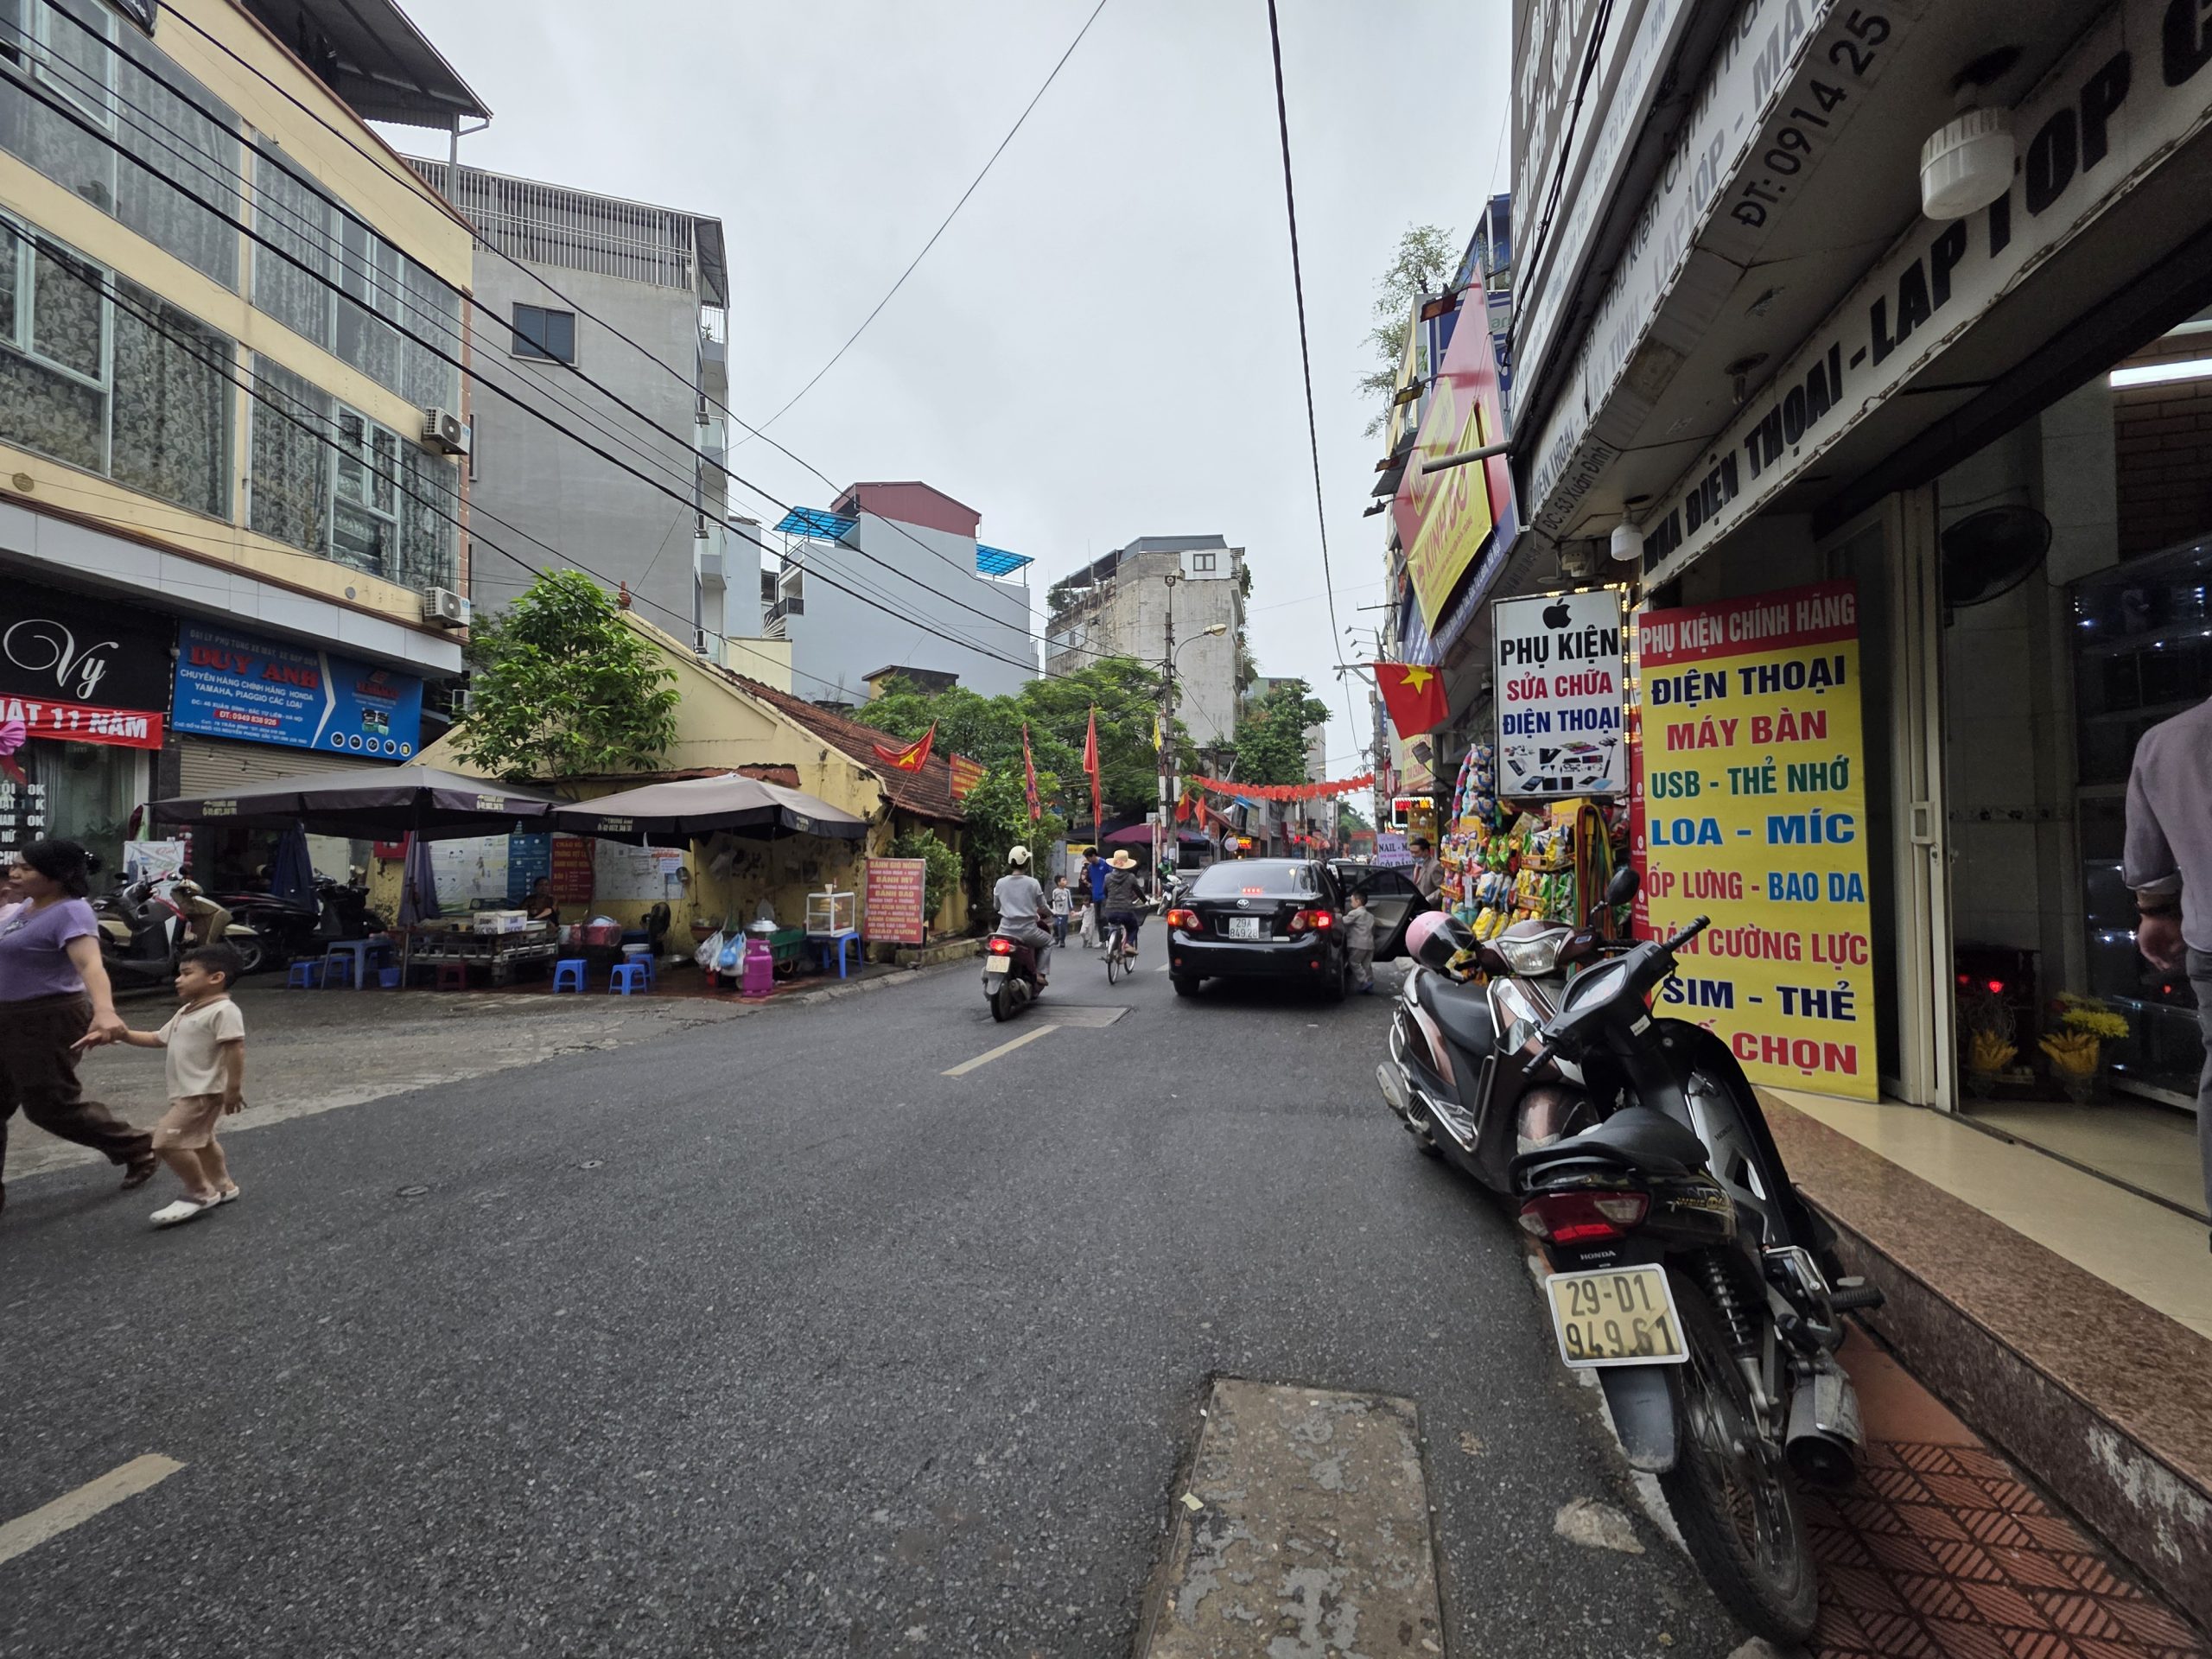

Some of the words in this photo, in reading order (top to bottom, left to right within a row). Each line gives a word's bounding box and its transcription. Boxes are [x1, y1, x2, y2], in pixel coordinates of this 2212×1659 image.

[1686, 449, 1739, 537] ĐIỆN
[1500, 635, 1549, 669] PHỤ
[1558, 624, 1618, 664] KIỆN
[1641, 626, 1675, 658] PHỤ
[1681, 612, 1723, 653] KIỆN
[1729, 602, 1789, 642] CHÍNH
[1796, 593, 1855, 632] HÃNG
[3, 619, 119, 699] Vy
[189, 645, 252, 674] DUY
[263, 663, 319, 690] ANH
[180, 669, 215, 683] CHUYÊN
[217, 674, 239, 688] HÀNG
[289, 690, 314, 701] HONDA
[235, 690, 268, 703] PIAGGIO
[1507, 671, 1548, 702] SỬA
[1554, 668, 1613, 697] CHỮA
[1651, 669, 1726, 708] ĐIỆN
[1738, 655, 1845, 694] THOẠI
[51, 708, 79, 730] 11
[89, 710, 147, 739] NĂM
[1503, 708, 1551, 739] ĐIỆN
[1557, 706, 1620, 734] THOẠI
[1667, 715, 1738, 751] MÁY
[1751, 707, 1827, 744] BÀN
[1651, 770, 1700, 798] USB
[1727, 755, 1777, 795] THẺ
[1787, 754, 1849, 792] NHỚ
[1379, 843, 1396, 852] NAIL
[1651, 817, 1723, 846] LOA
[1767, 808, 1855, 845] MÍC
[1648, 861, 1675, 898] ỐP
[1682, 868, 1743, 899] LƯNG
[1768, 872, 1819, 901] BAO
[1828, 873, 1866, 902] DA
[1236, 918, 1252, 928] 29A
[1707, 923, 1802, 961] CƯỜNG
[1811, 931, 1869, 970] LỰC
[1662, 976, 1734, 1009] SIM
[1777, 980, 1857, 1021] THẺ
[1732, 1032, 1857, 1076] CHỌN
[1580, 1249, 1617, 1261] HONDA
[1566, 1274, 1652, 1317] 29-D1
